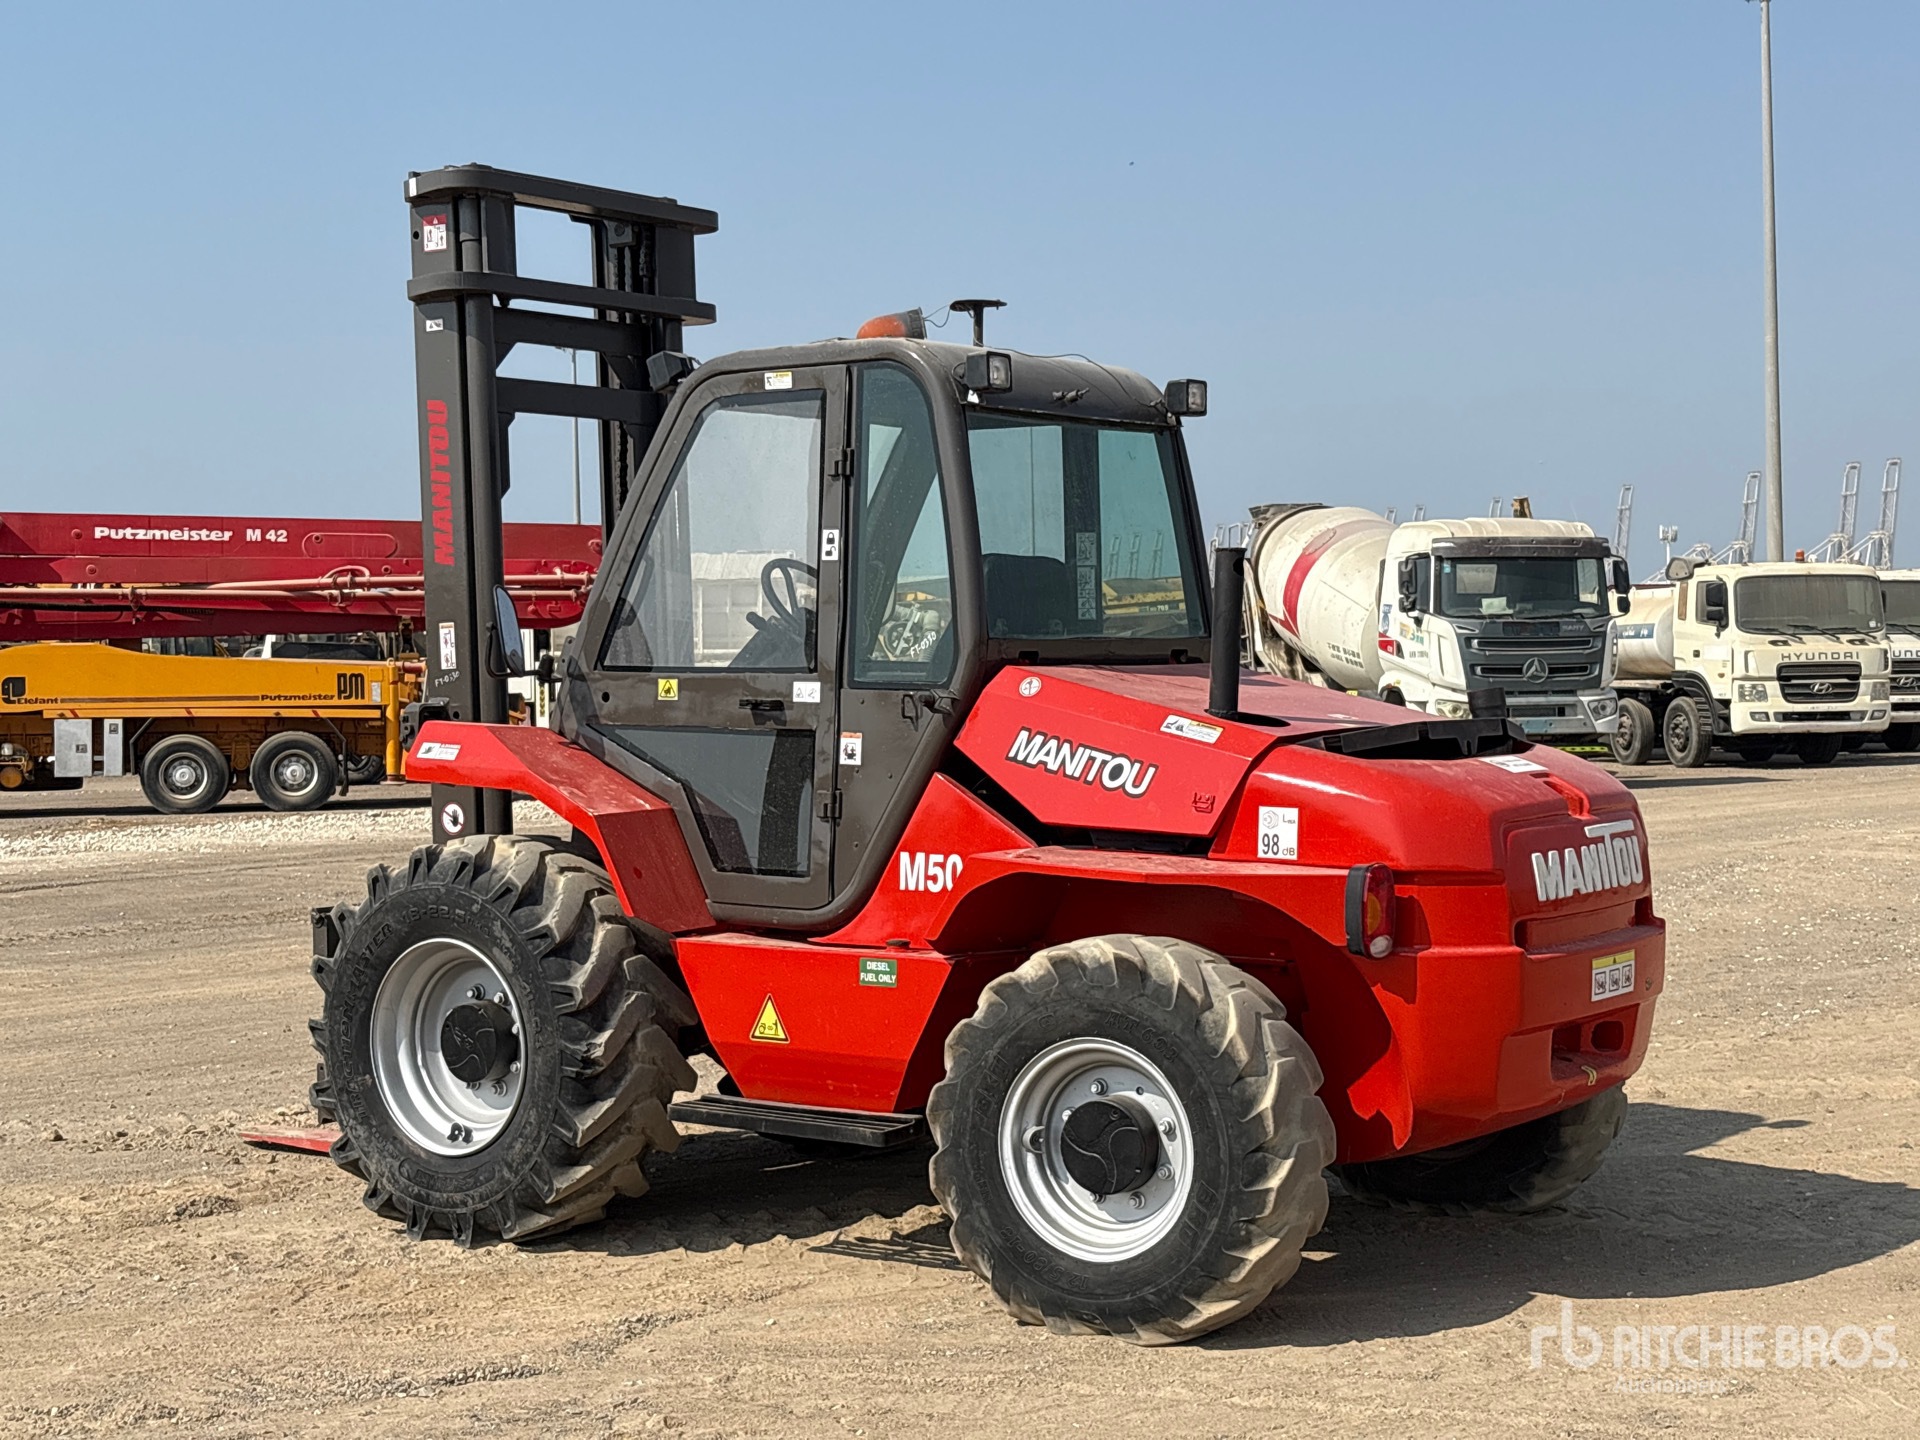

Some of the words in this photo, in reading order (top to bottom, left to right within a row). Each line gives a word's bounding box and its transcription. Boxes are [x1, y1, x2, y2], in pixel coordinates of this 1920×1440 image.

[427, 400, 456, 566] MANITOU
[94, 526, 233, 542] Putzmeister
[246, 529, 262, 542] M
[265, 529, 288, 543] 42
[1780, 651, 1860, 662] HYUNDAI
[260, 693, 336, 702] Putzmeister
[1007, 728, 1157, 796] MANITOU
[1261, 833, 1280, 856] 98
[1531, 818, 1644, 902] MANITOU
[899, 851, 964, 893] M50
[866, 961, 891, 972] DIESEL
[860, 972, 878, 983] FUEL
[878, 973, 897, 984] ONLY
